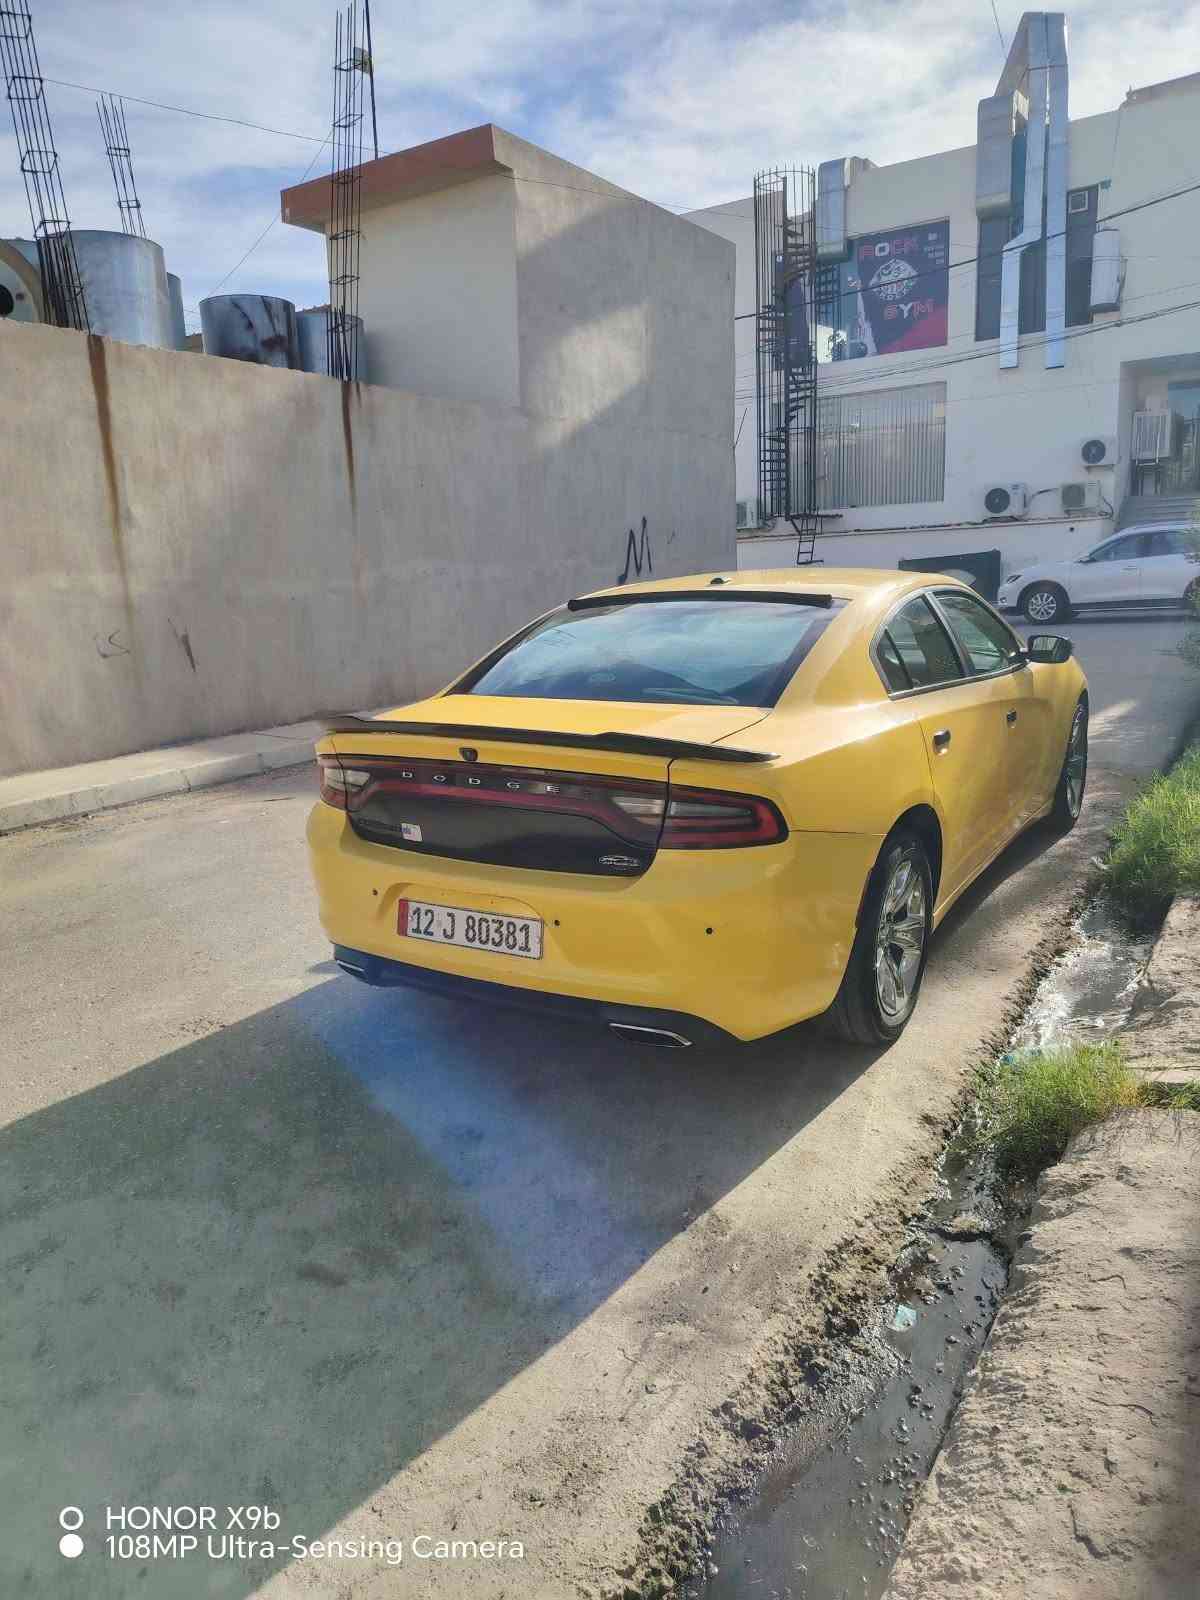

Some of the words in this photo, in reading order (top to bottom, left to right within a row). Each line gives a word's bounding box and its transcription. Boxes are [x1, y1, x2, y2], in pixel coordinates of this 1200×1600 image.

[402, 770, 561, 793] DODGE
[411, 907, 435, 936] 12
[442, 911, 456, 939] J
[465, 915, 532, 952] 80381
